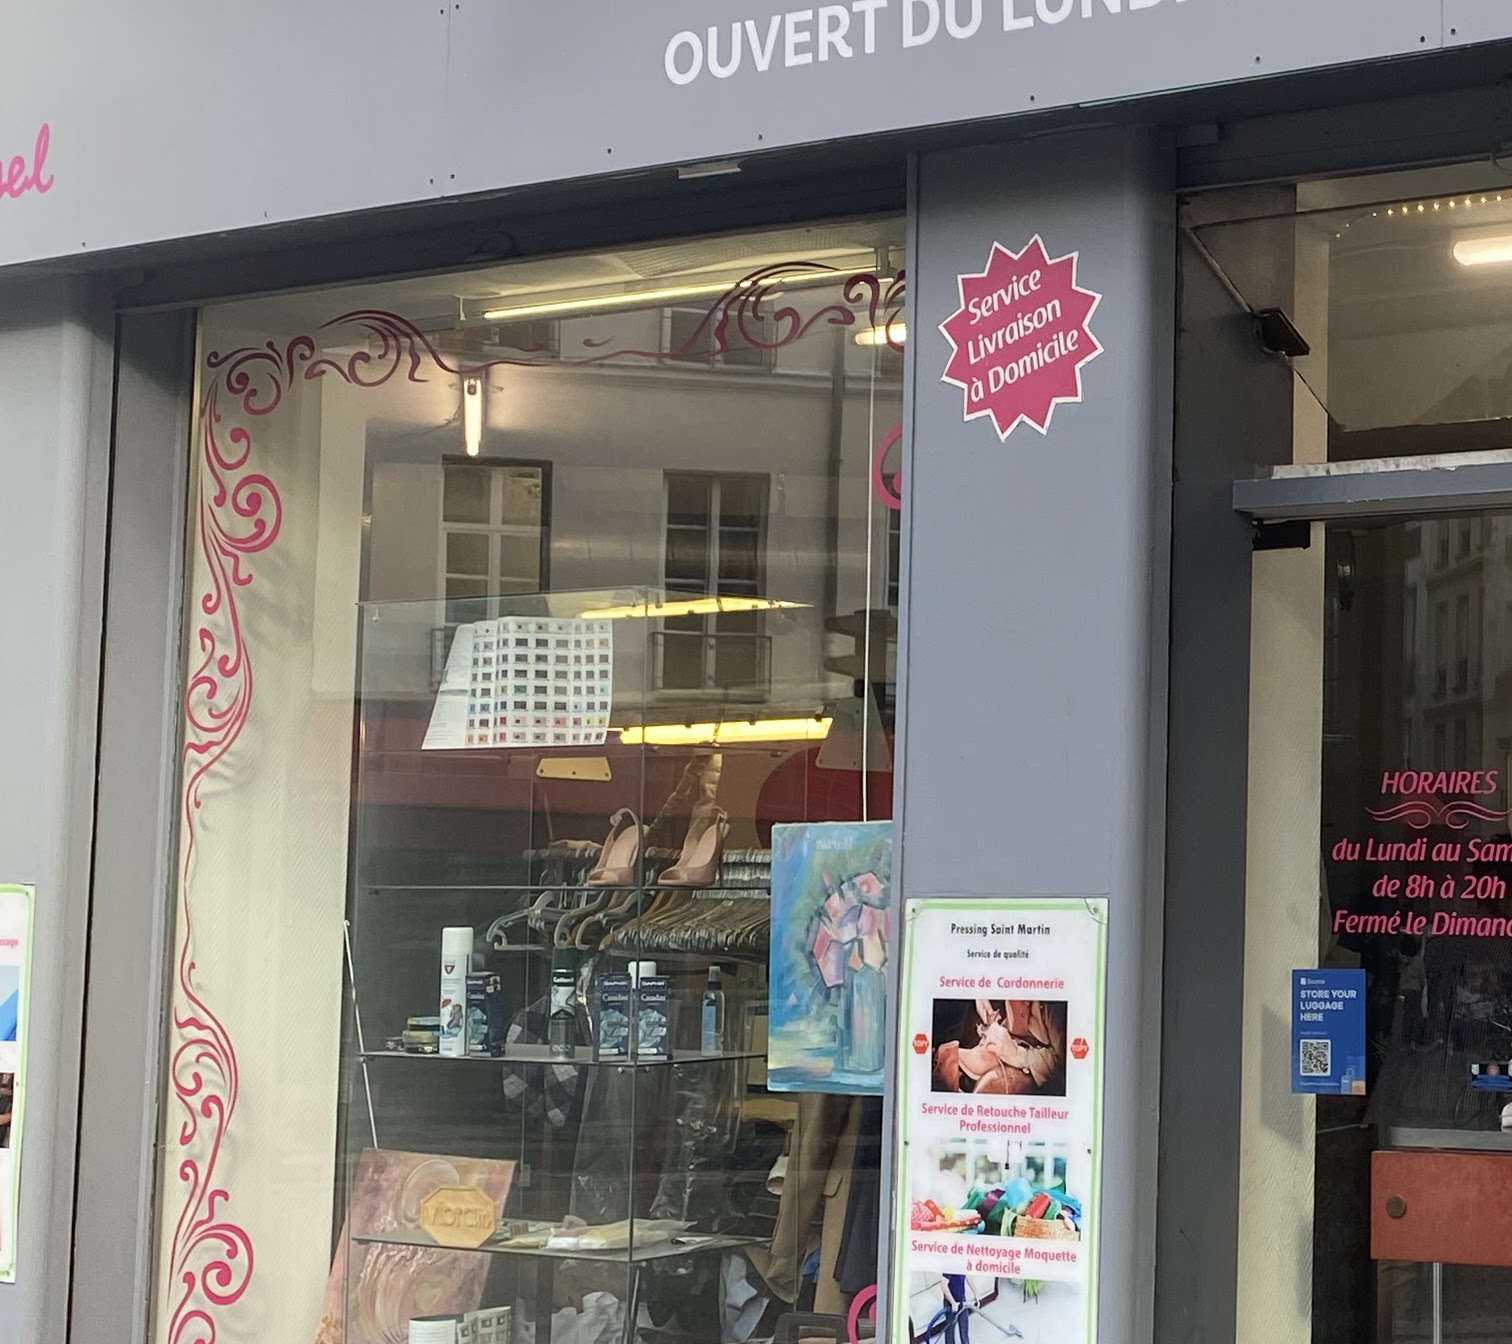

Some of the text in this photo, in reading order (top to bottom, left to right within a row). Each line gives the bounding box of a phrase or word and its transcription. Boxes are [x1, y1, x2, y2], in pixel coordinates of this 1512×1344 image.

[0, 122, 55, 199] el
[967, 269, 1041, 326] Service
[967, 298, 1062, 365] Livraison
[970, 329, 1079, 403] à Domicile
[1380, 769, 1499, 795] HORAIRES
[1331, 837, 1361, 861] du
[1365, 837, 1428, 862] Lundi
[1431, 843, 1462, 862] au
[1372, 874, 1400, 898] de
[1405, 874, 1434, 899] 8h
[1439, 874, 1455, 899] à
[1459, 874, 1506, 899] 20h
[950, 923, 1051, 937] Pressing Saint Martin
[1333, 909, 1401, 934] Fermé
[1405, 910, 1427, 935] le
[966, 949, 1030, 960] Service de qualité
[939, 975, 1065, 990] Service de Cordonnerie
[1299, 989, 1357, 999] STORE YOUR
[1299, 1001, 1344, 1011] LUGGAGE
[1299, 1013, 1324, 1022] HERE
[921, 1103, 1069, 1120] Service de Retouche Tailleur
[959, 1120, 1031, 1134] Professionnel
[911, 1239, 1077, 1263] Service de Nettoyage Moquette
[966, 1259, 1021, 1274] à domicile
